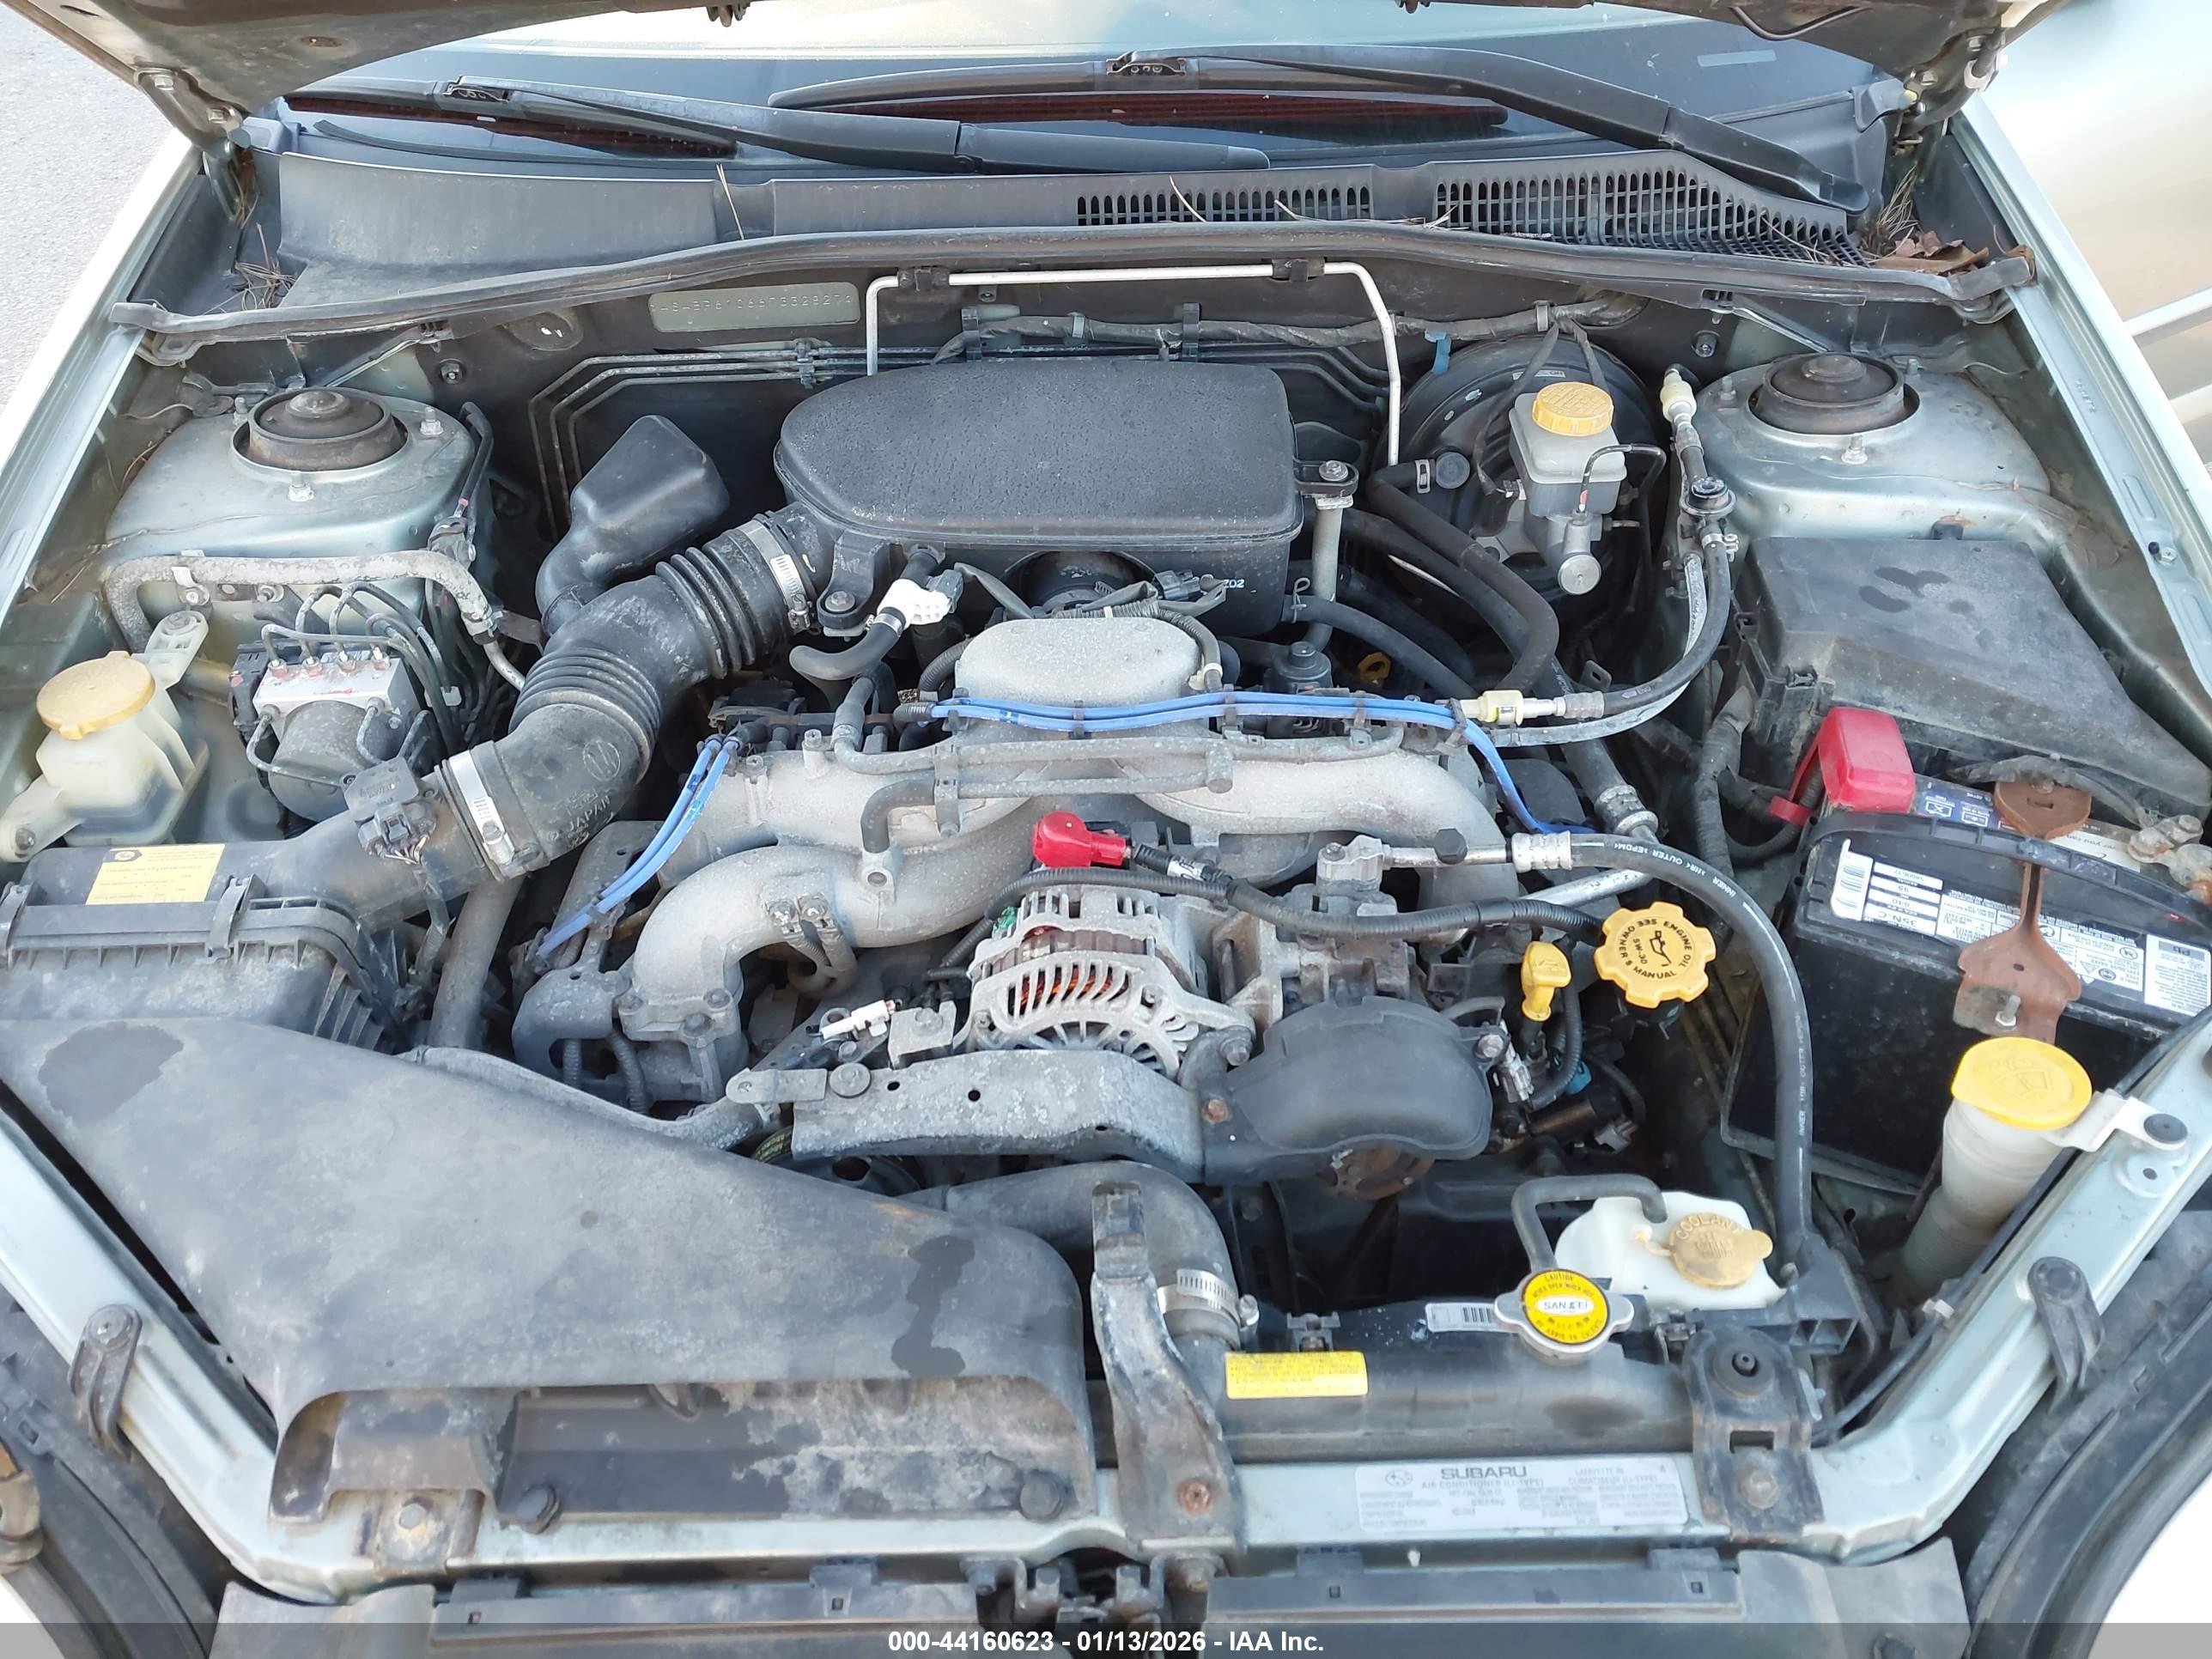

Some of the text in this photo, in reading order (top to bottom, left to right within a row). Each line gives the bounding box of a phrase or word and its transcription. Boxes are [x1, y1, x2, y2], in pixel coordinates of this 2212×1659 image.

[1651, 848, 1684, 866] OUTER
[1711, 876, 1737, 898] INNER
[1637, 919, 1693, 968] SEE ENGINE OIL
[1633, 965, 1677, 980] MANUAL
[1440, 1466, 1527, 1480] SUBARU
